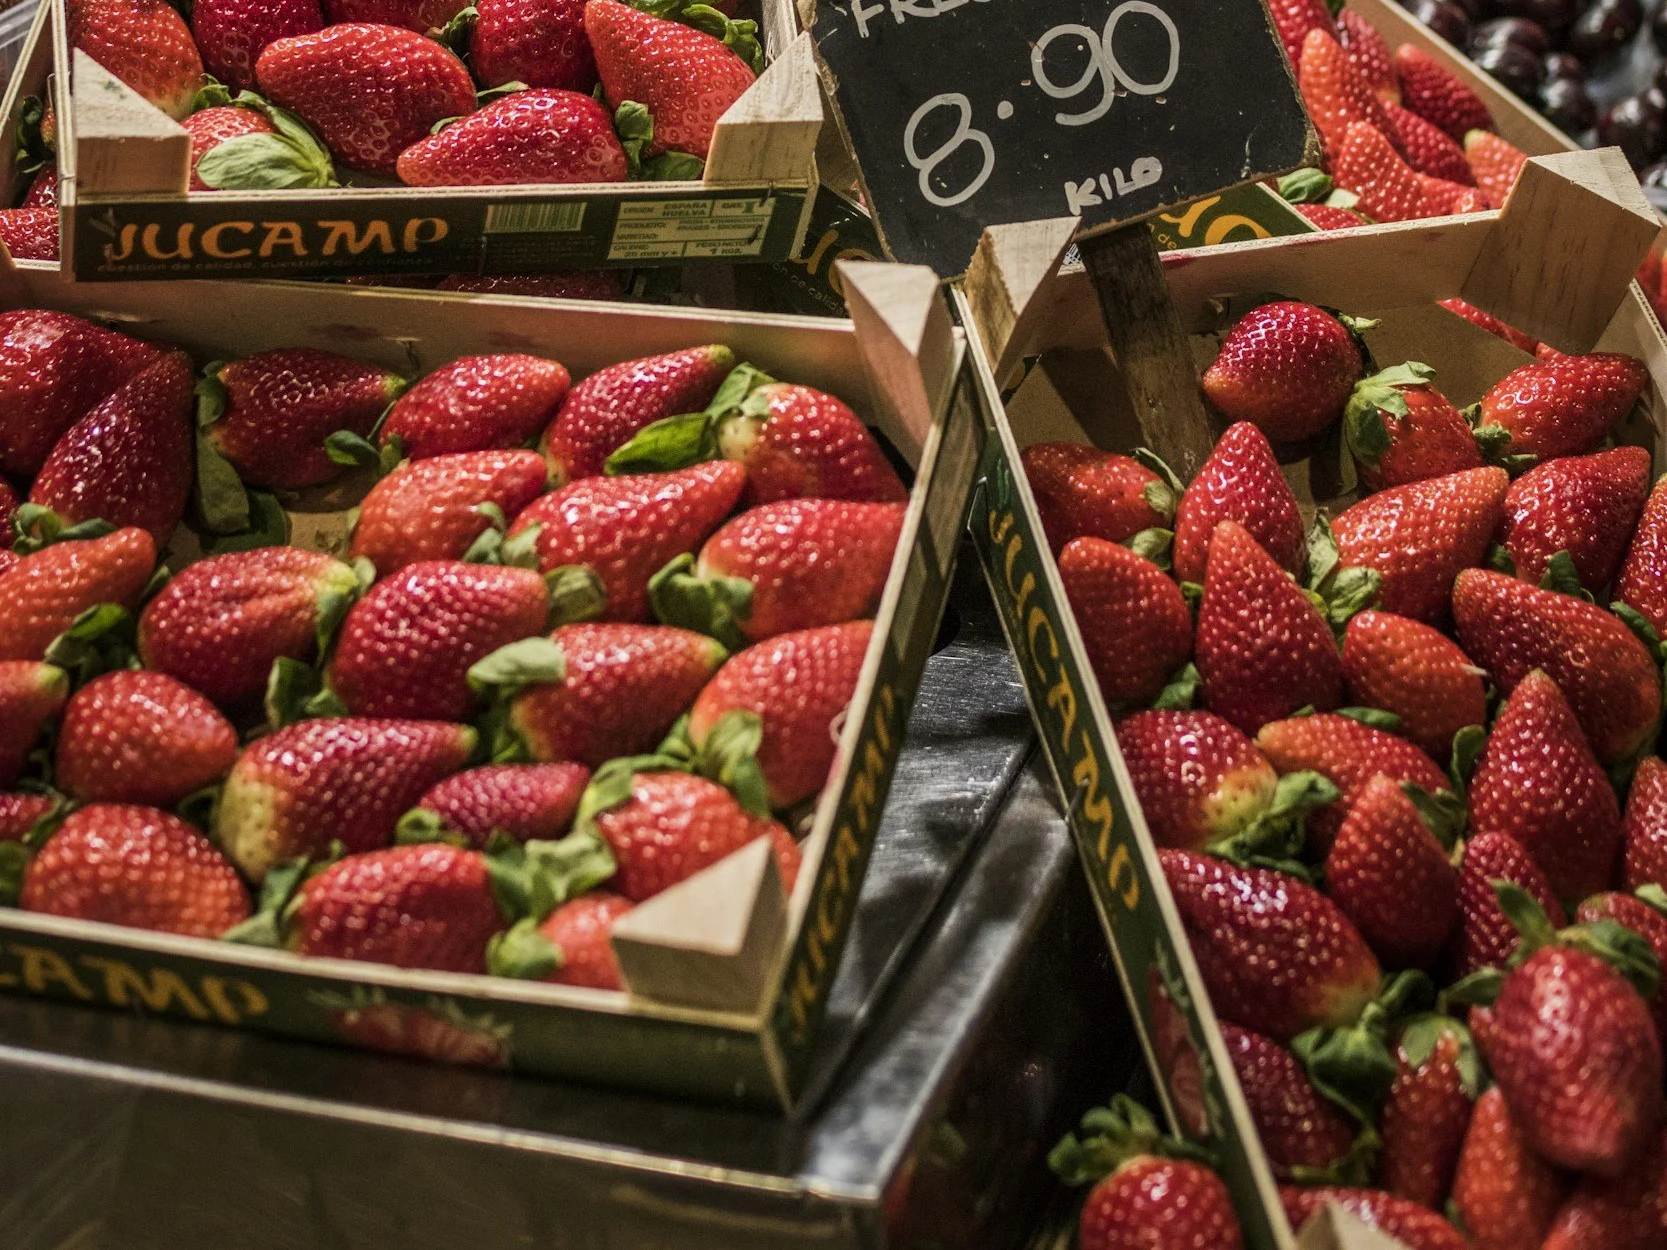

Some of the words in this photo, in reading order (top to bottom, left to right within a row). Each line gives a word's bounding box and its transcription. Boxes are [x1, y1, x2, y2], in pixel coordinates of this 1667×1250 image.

[903, 0, 1180, 207] 8.90
[1064, 156, 1163, 217] KILO
[664, 202, 707, 210] ESPAÑA
[111, 217, 449, 260] JUCAMP
[1157, 233, 1178, 250] de
[171, 262, 192, 270] de
[624, 250, 638, 258] 25
[989, 508, 1141, 911] JUCAMP
